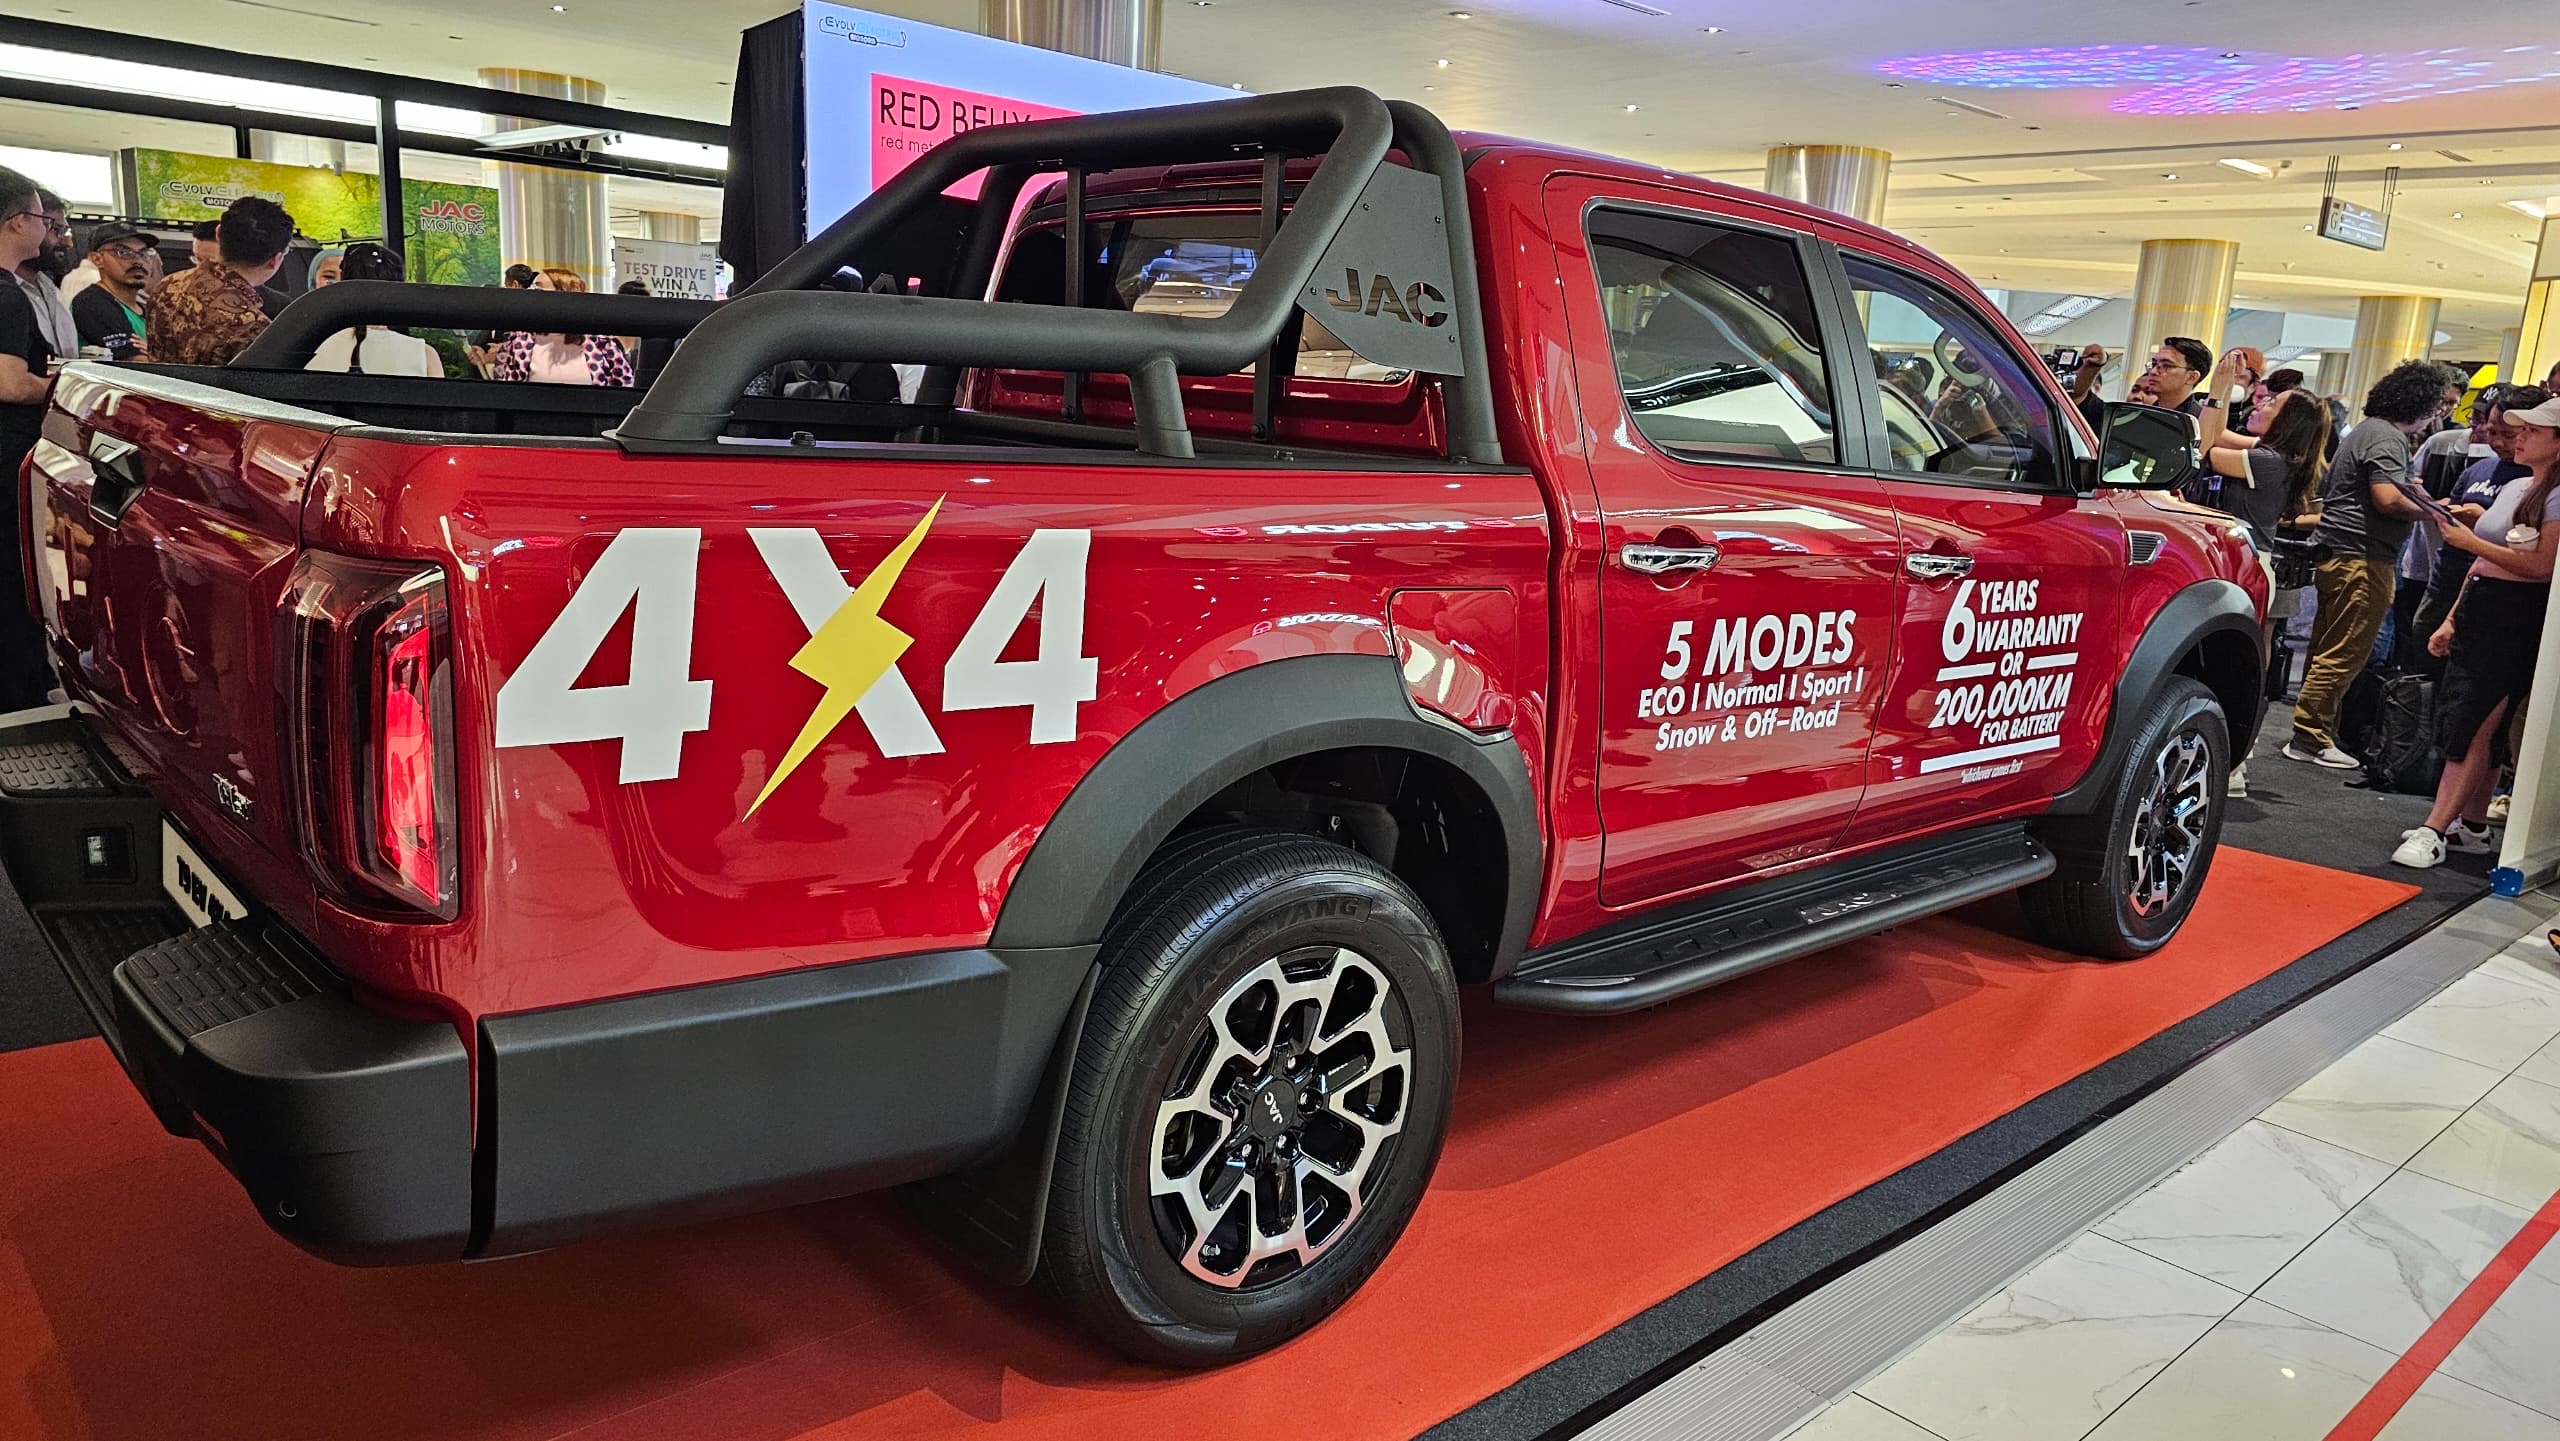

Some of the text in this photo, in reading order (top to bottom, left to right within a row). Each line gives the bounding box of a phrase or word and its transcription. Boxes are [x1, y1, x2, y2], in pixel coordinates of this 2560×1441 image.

[825, 16, 856, 31] EVOLV
[880, 87, 941, 131] RED
[881, 131, 904, 150] red
[169, 181, 213, 195] EVOLV
[421, 200, 485, 221] JAC
[421, 217, 485, 235] MOTORS
[624, 262, 707, 281] TEST DRIVE
[651, 277, 683, 291] WIN
[688, 281, 698, 292] A
[1325, 268, 1449, 328] JAC
[1942, 579, 2040, 663] 6 YEARS
[1975, 612, 2084, 653] WARRANTY
[495, 492, 1099, 823] 4X4
[1660, 609, 1857, 680] 5 MODES
[2000, 651, 2024, 677] OR
[1638, 685, 1686, 718] ECO
[1704, 673, 1786, 711] Normal
[1801, 670, 1852, 704] Sport
[1928, 672, 2074, 729] 200,000KM
[1655, 701, 1841, 752] Snow & Off-Road
[1979, 710, 2065, 744] FOR BATTERY
[1264, 1091, 1283, 1124] JAC
